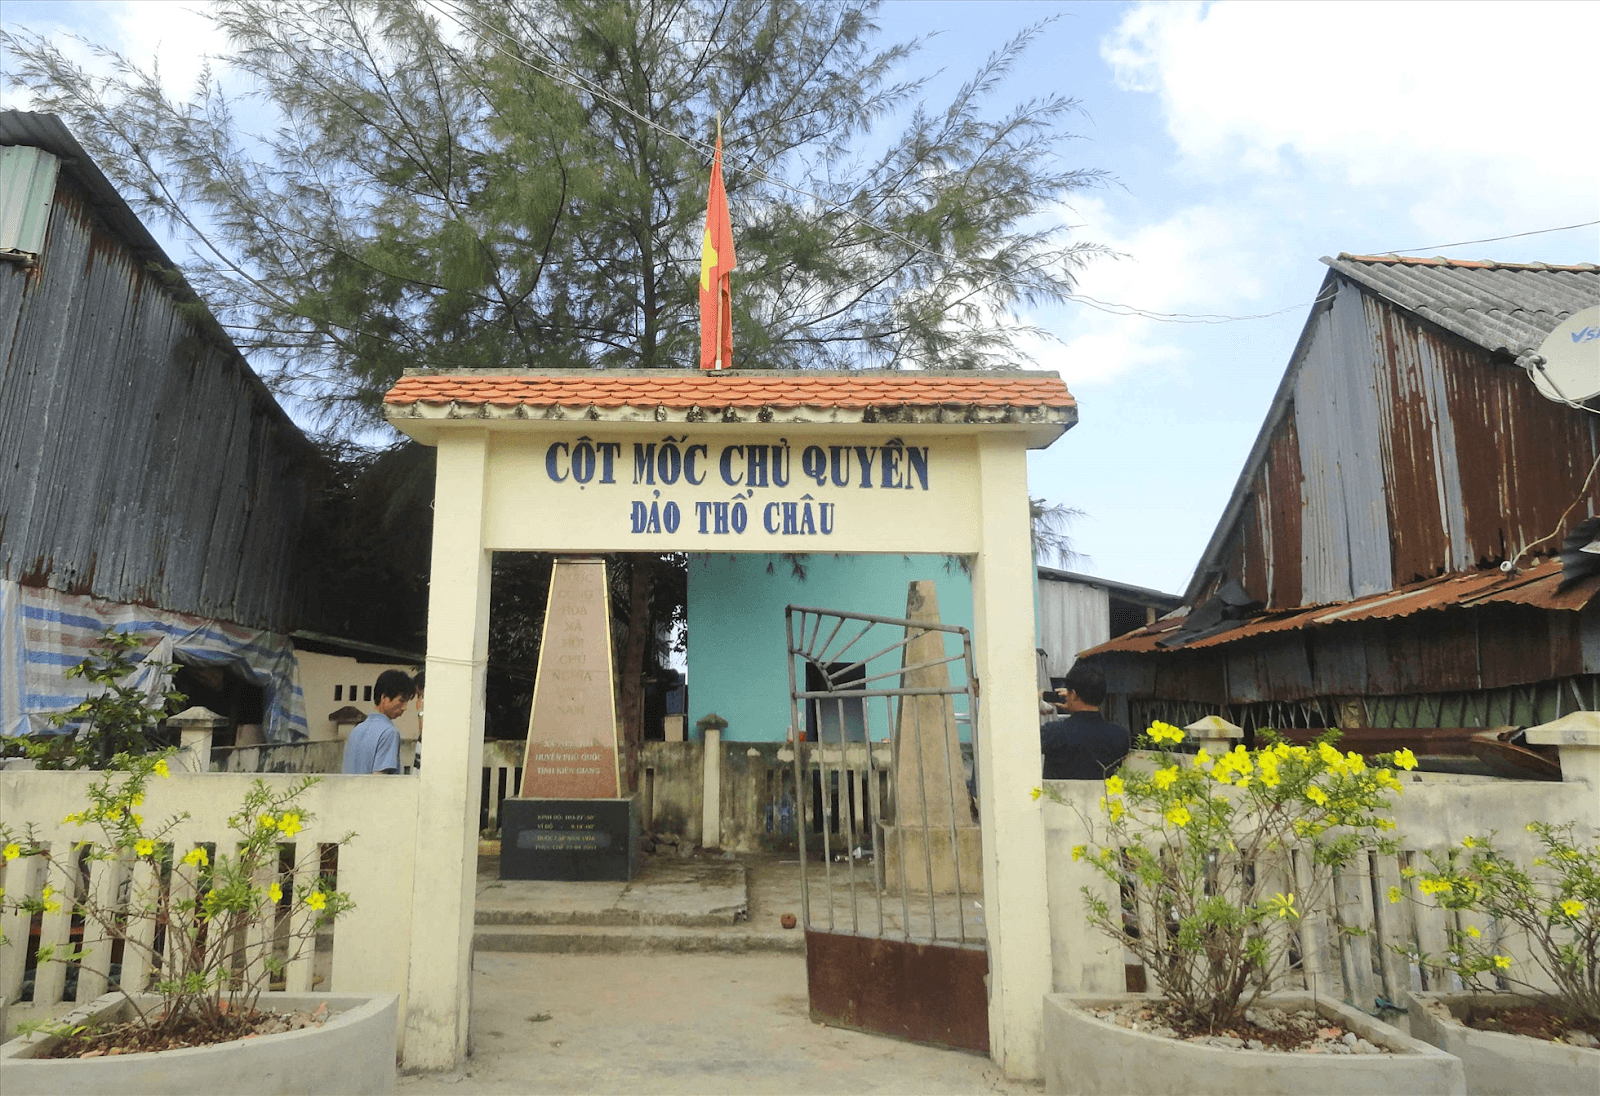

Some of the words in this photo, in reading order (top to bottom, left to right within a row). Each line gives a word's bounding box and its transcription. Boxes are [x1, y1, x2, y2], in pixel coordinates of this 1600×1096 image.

[545, 435, 621, 490] CỘT
[632, 434, 708, 487] MỐC
[719, 436, 792, 489] CHỦ
[801, 437, 930, 491] QUYỀN
[630, 489, 681, 535] ĐẢO
[695, 488, 754, 535] THỔ
[763, 493, 835, 536] CHÂU
